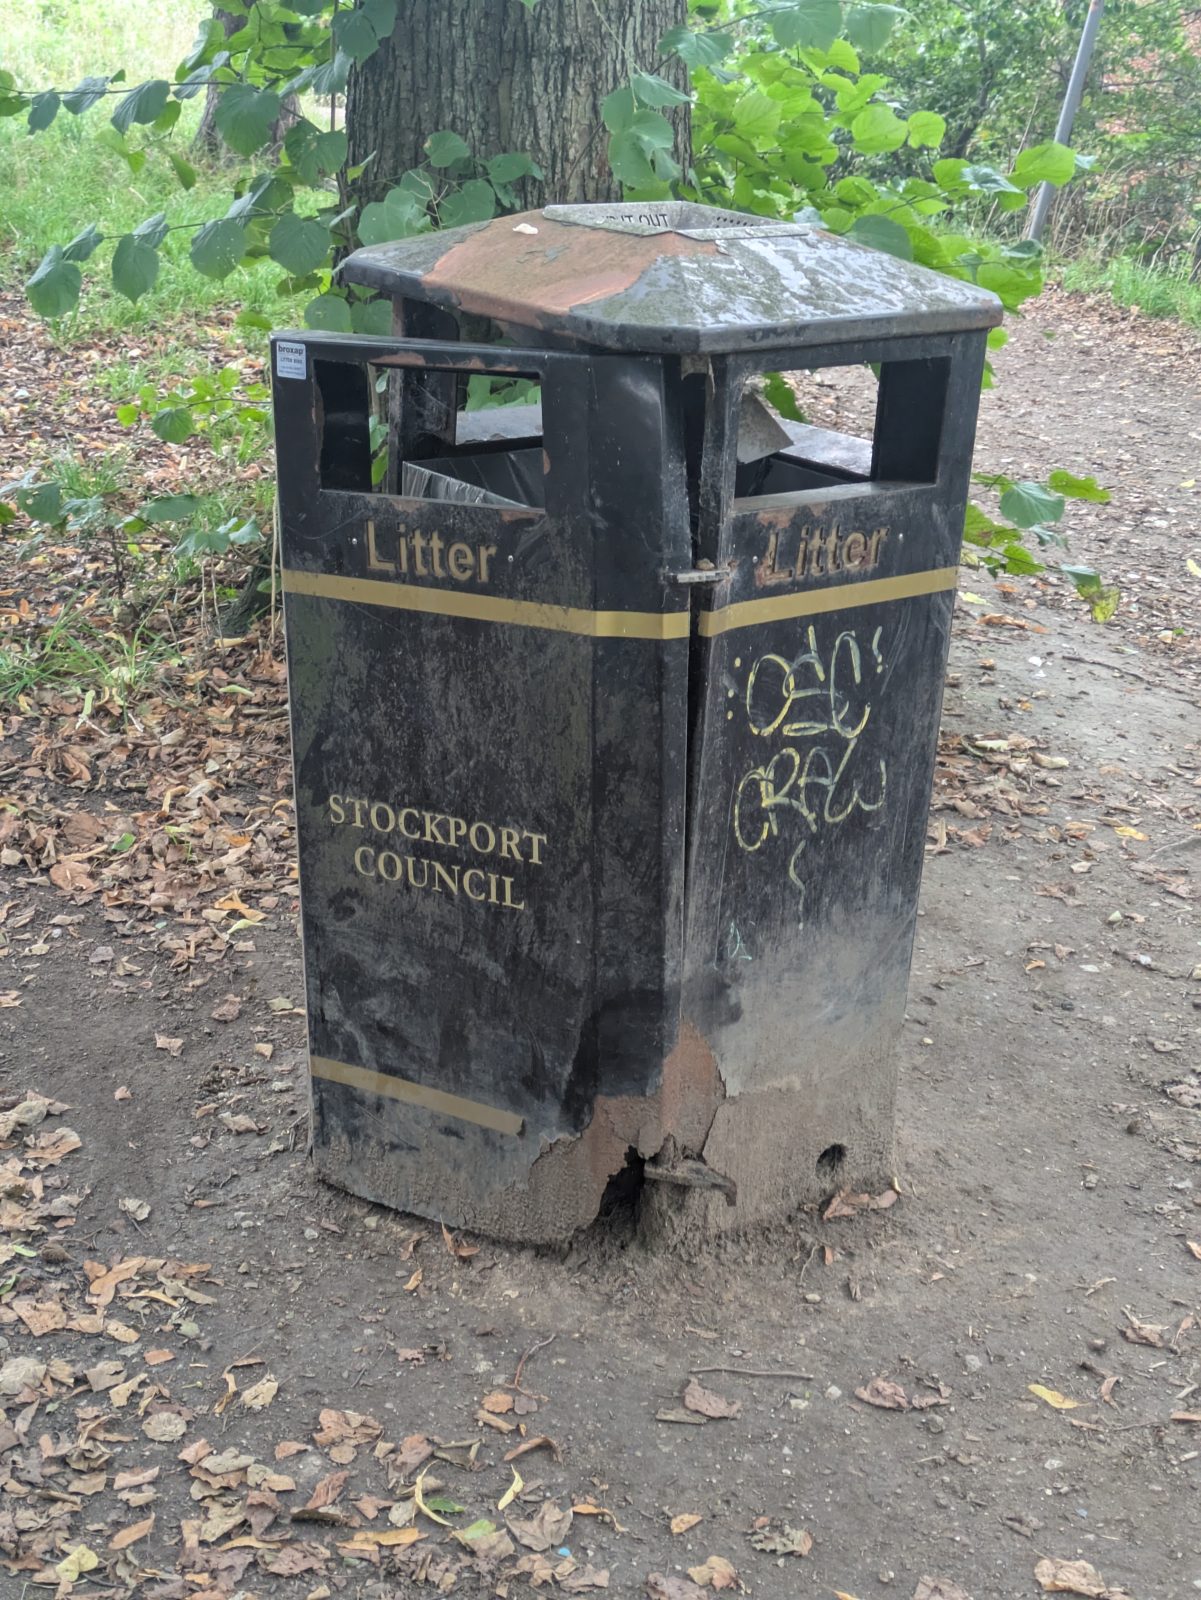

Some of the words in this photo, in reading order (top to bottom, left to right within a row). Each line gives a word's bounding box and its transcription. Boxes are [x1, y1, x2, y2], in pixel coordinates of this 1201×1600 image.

[279, 344, 303, 355] broxap
[367, 519, 498, 583] Litter
[763, 523, 890, 581] Litter
[329, 794, 548, 865] STOCKPORT
[354, 846, 525, 911] COUNCIL
